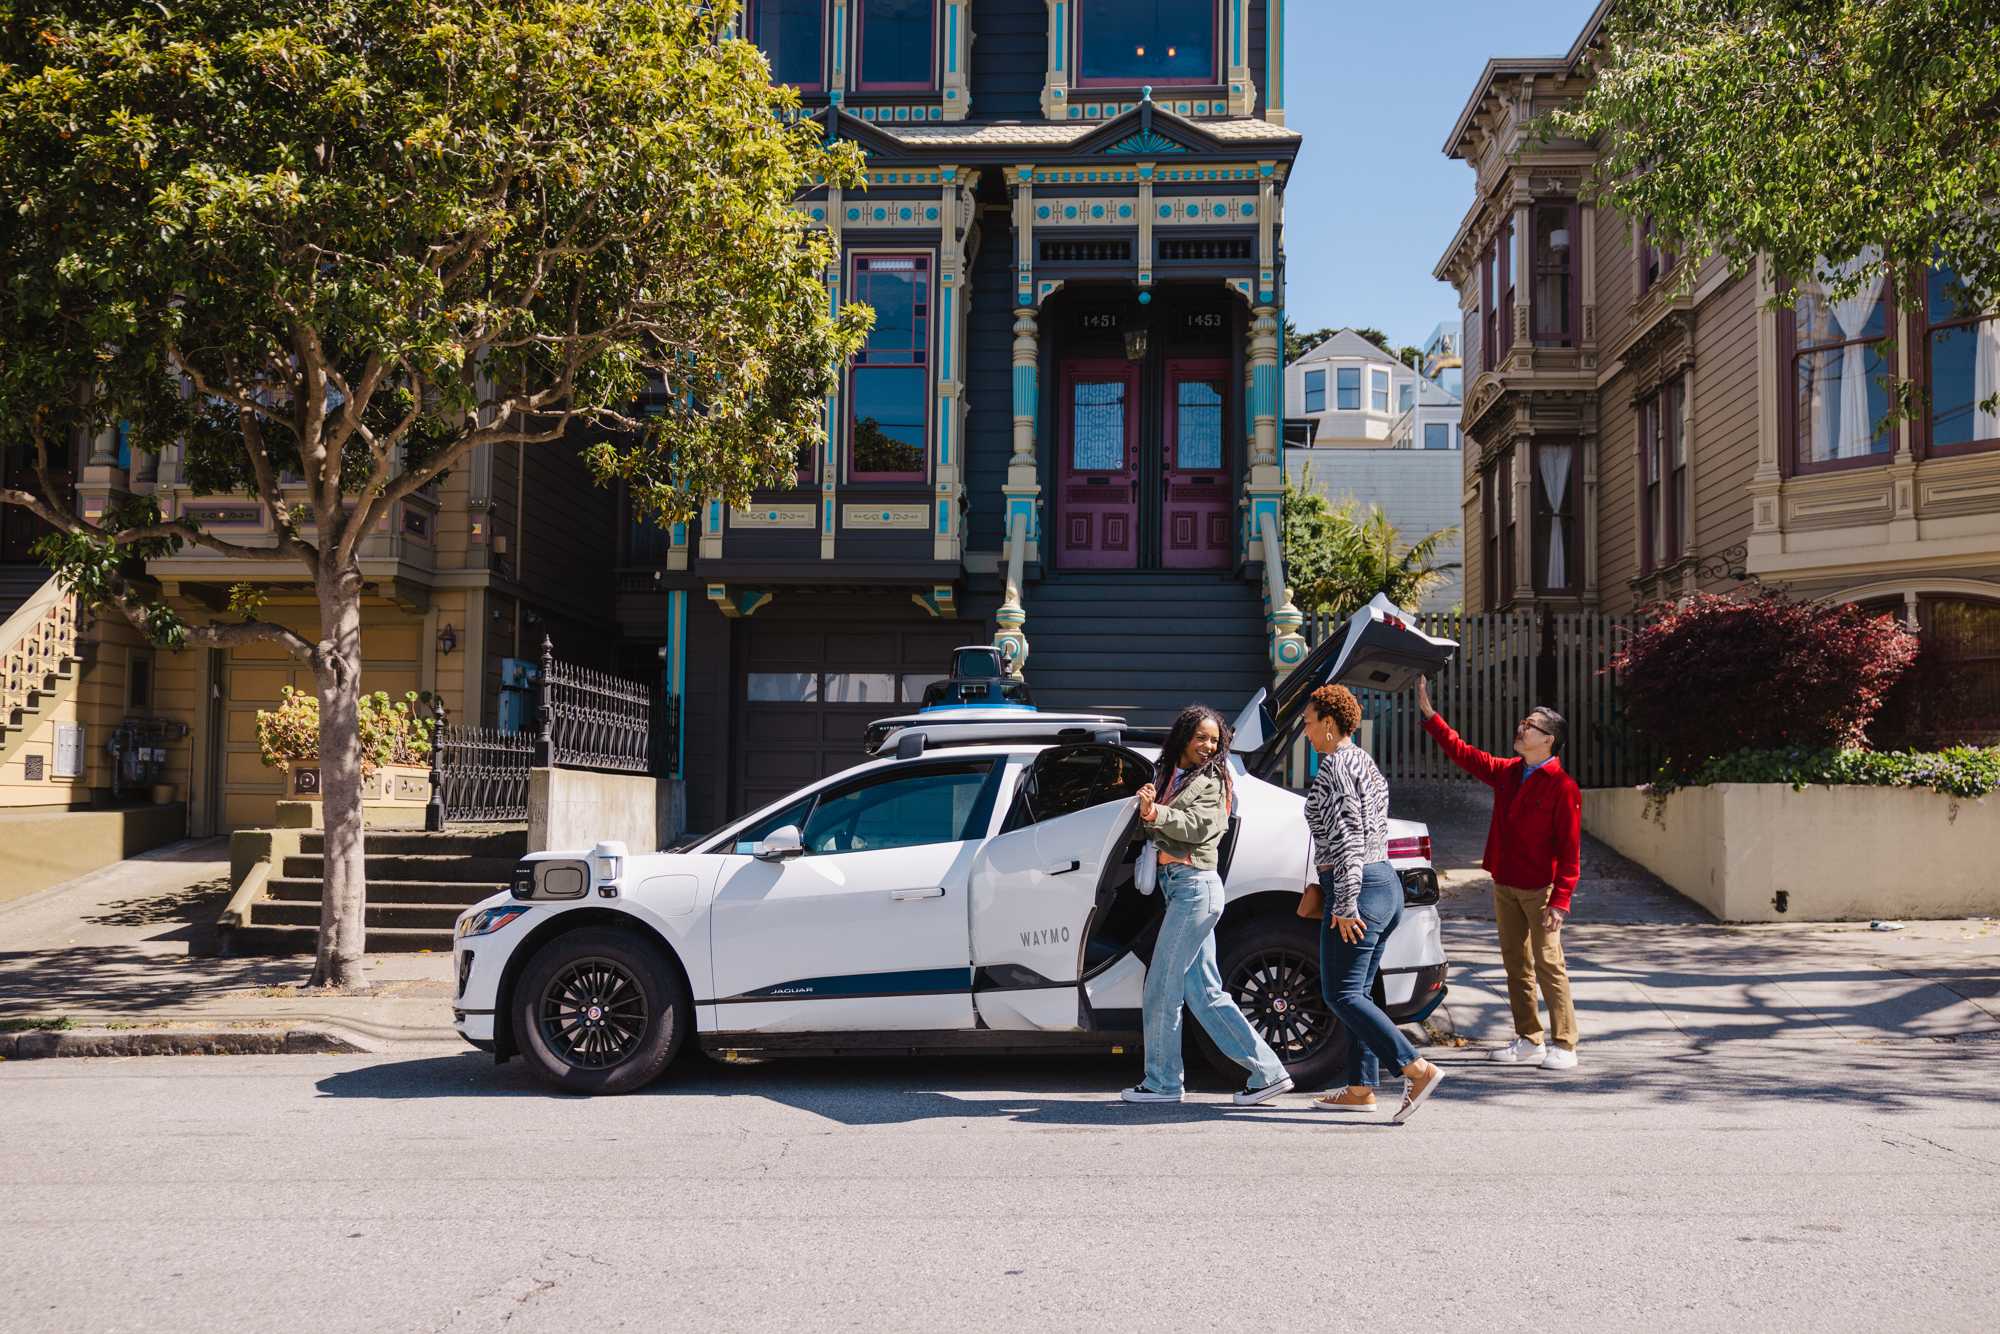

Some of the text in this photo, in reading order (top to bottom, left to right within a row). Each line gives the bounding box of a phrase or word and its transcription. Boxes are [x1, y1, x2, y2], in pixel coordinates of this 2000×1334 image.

[1084, 315, 1116, 327] 1451
[1188, 314, 1221, 326] 1453
[1020, 926, 1070, 947] WAYMO
